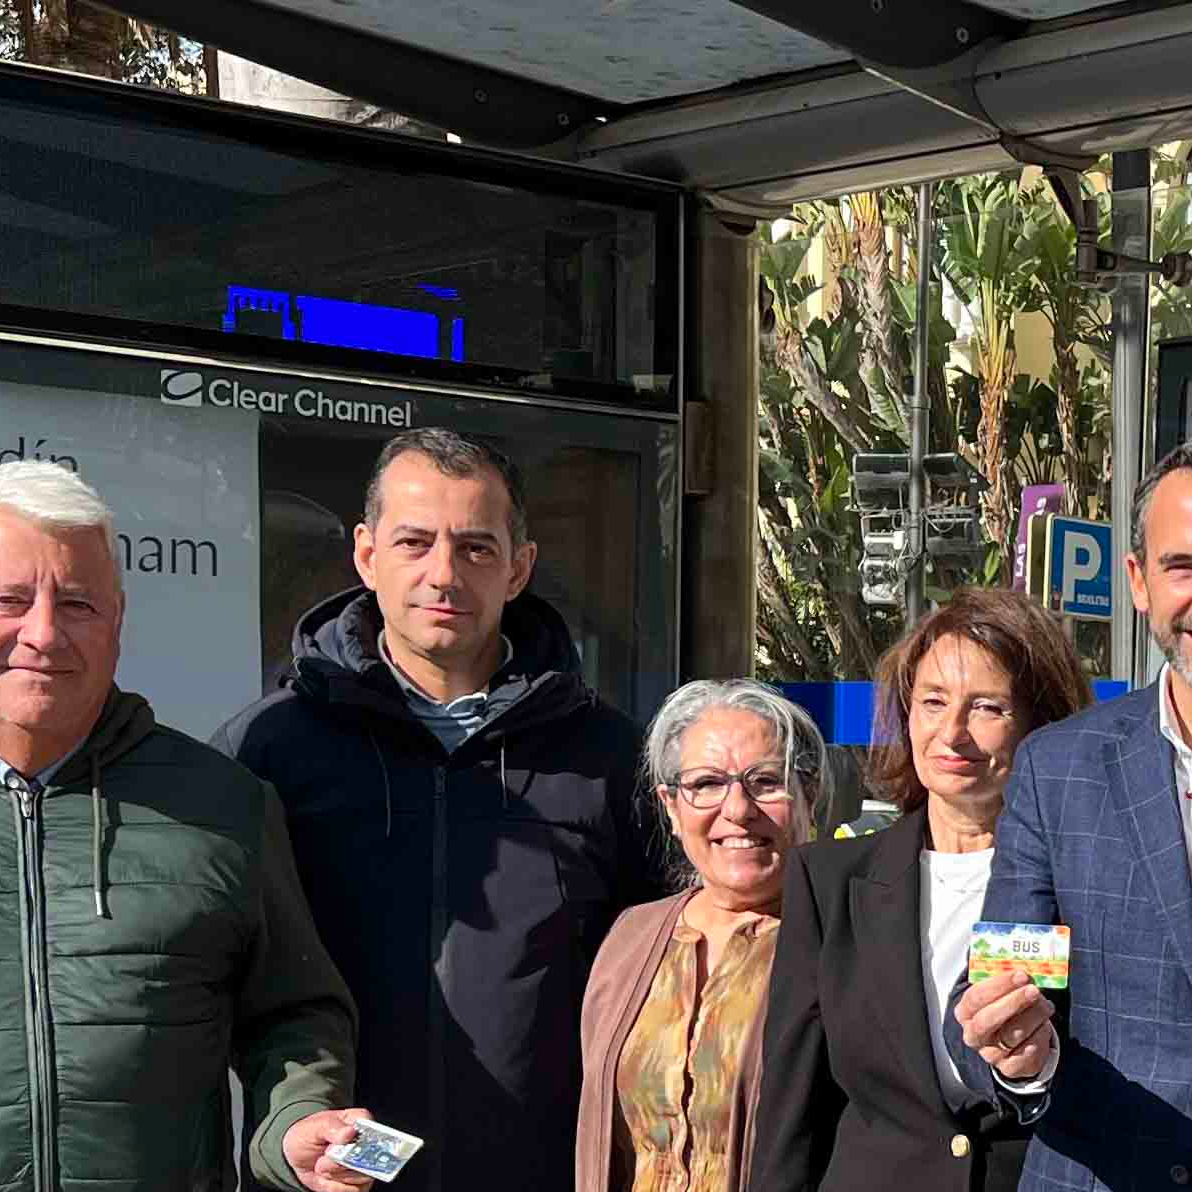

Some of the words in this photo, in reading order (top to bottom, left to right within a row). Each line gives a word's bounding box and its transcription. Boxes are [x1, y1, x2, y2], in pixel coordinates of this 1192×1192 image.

[208, 379, 290, 414] Clear
[294, 389, 412, 428] Channel
[1062, 530, 1102, 603] P
[1011, 940, 1041, 954] BUS
